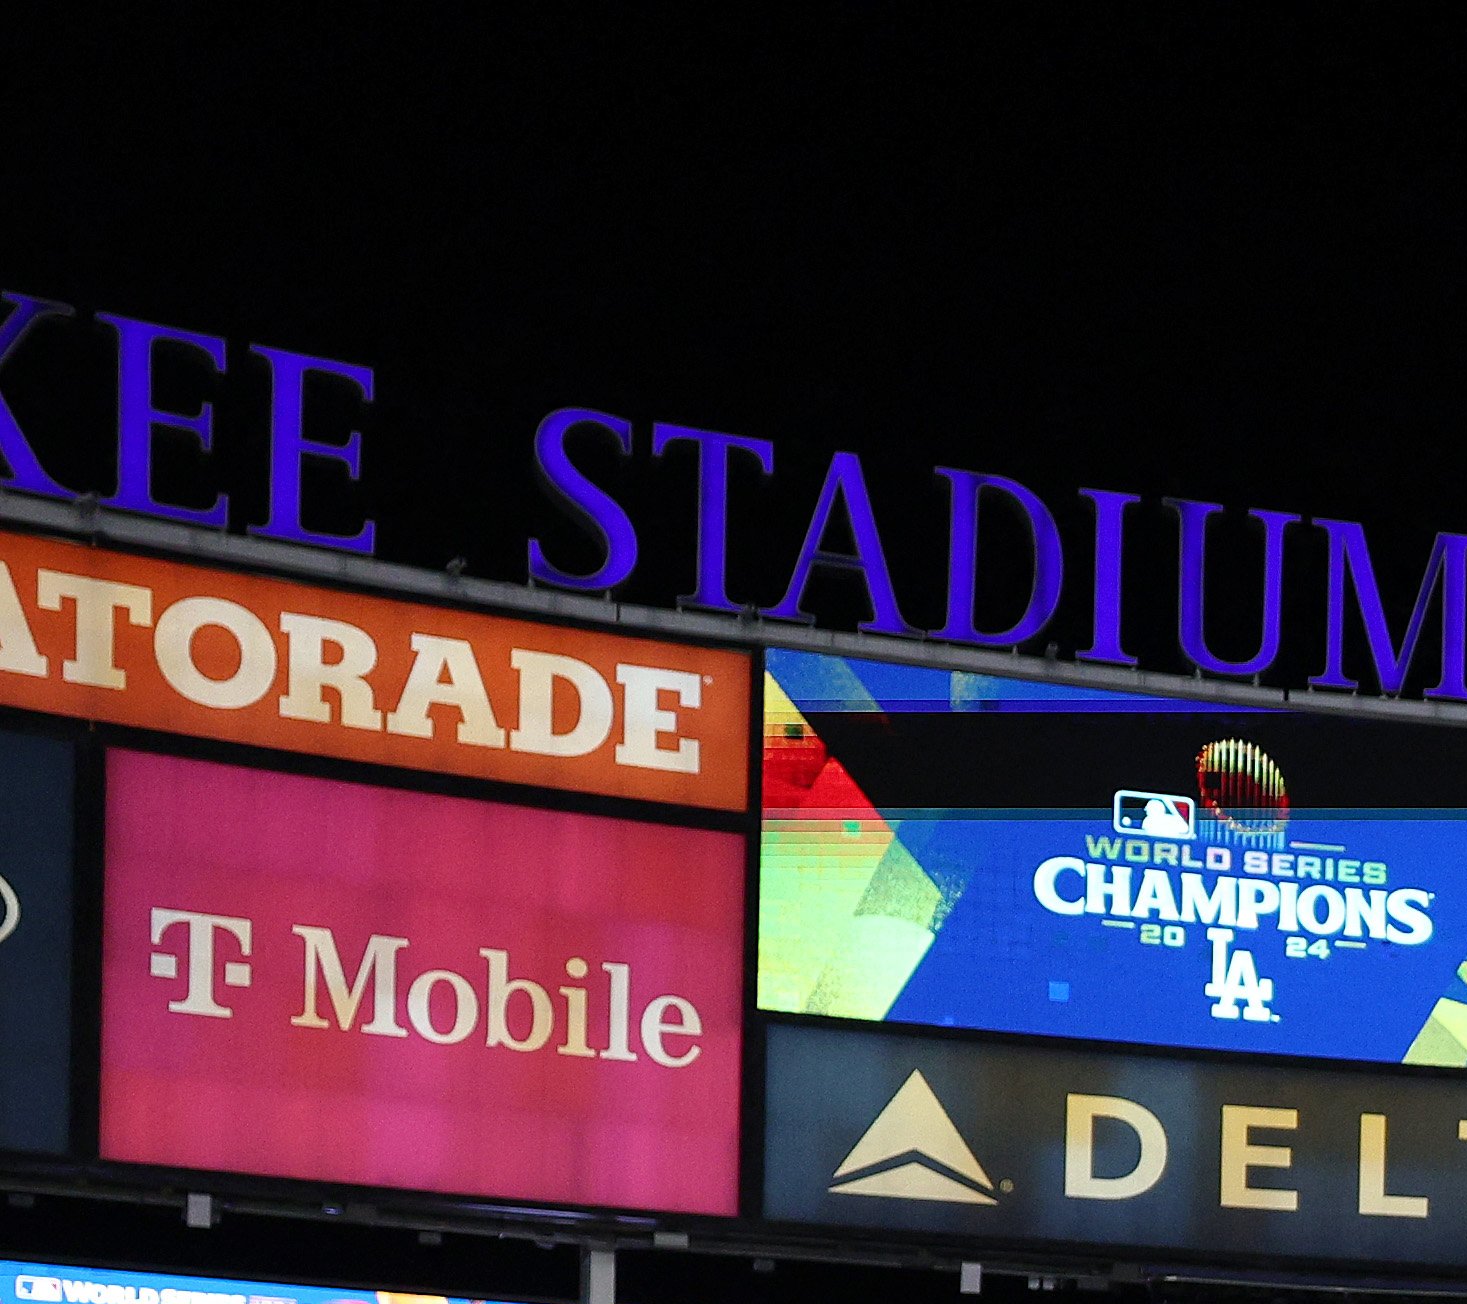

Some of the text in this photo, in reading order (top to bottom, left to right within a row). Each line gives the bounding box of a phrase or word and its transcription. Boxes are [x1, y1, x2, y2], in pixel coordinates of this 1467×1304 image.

[1033, 855, 1433, 945] CHAMPIONS
[1085, 834, 1388, 884] WORLD SERIES
[1140, 923, 1331, 958] 20 24
[1205, 926, 1275, 1023] LA
[291, 925, 702, 1068] Mobile
